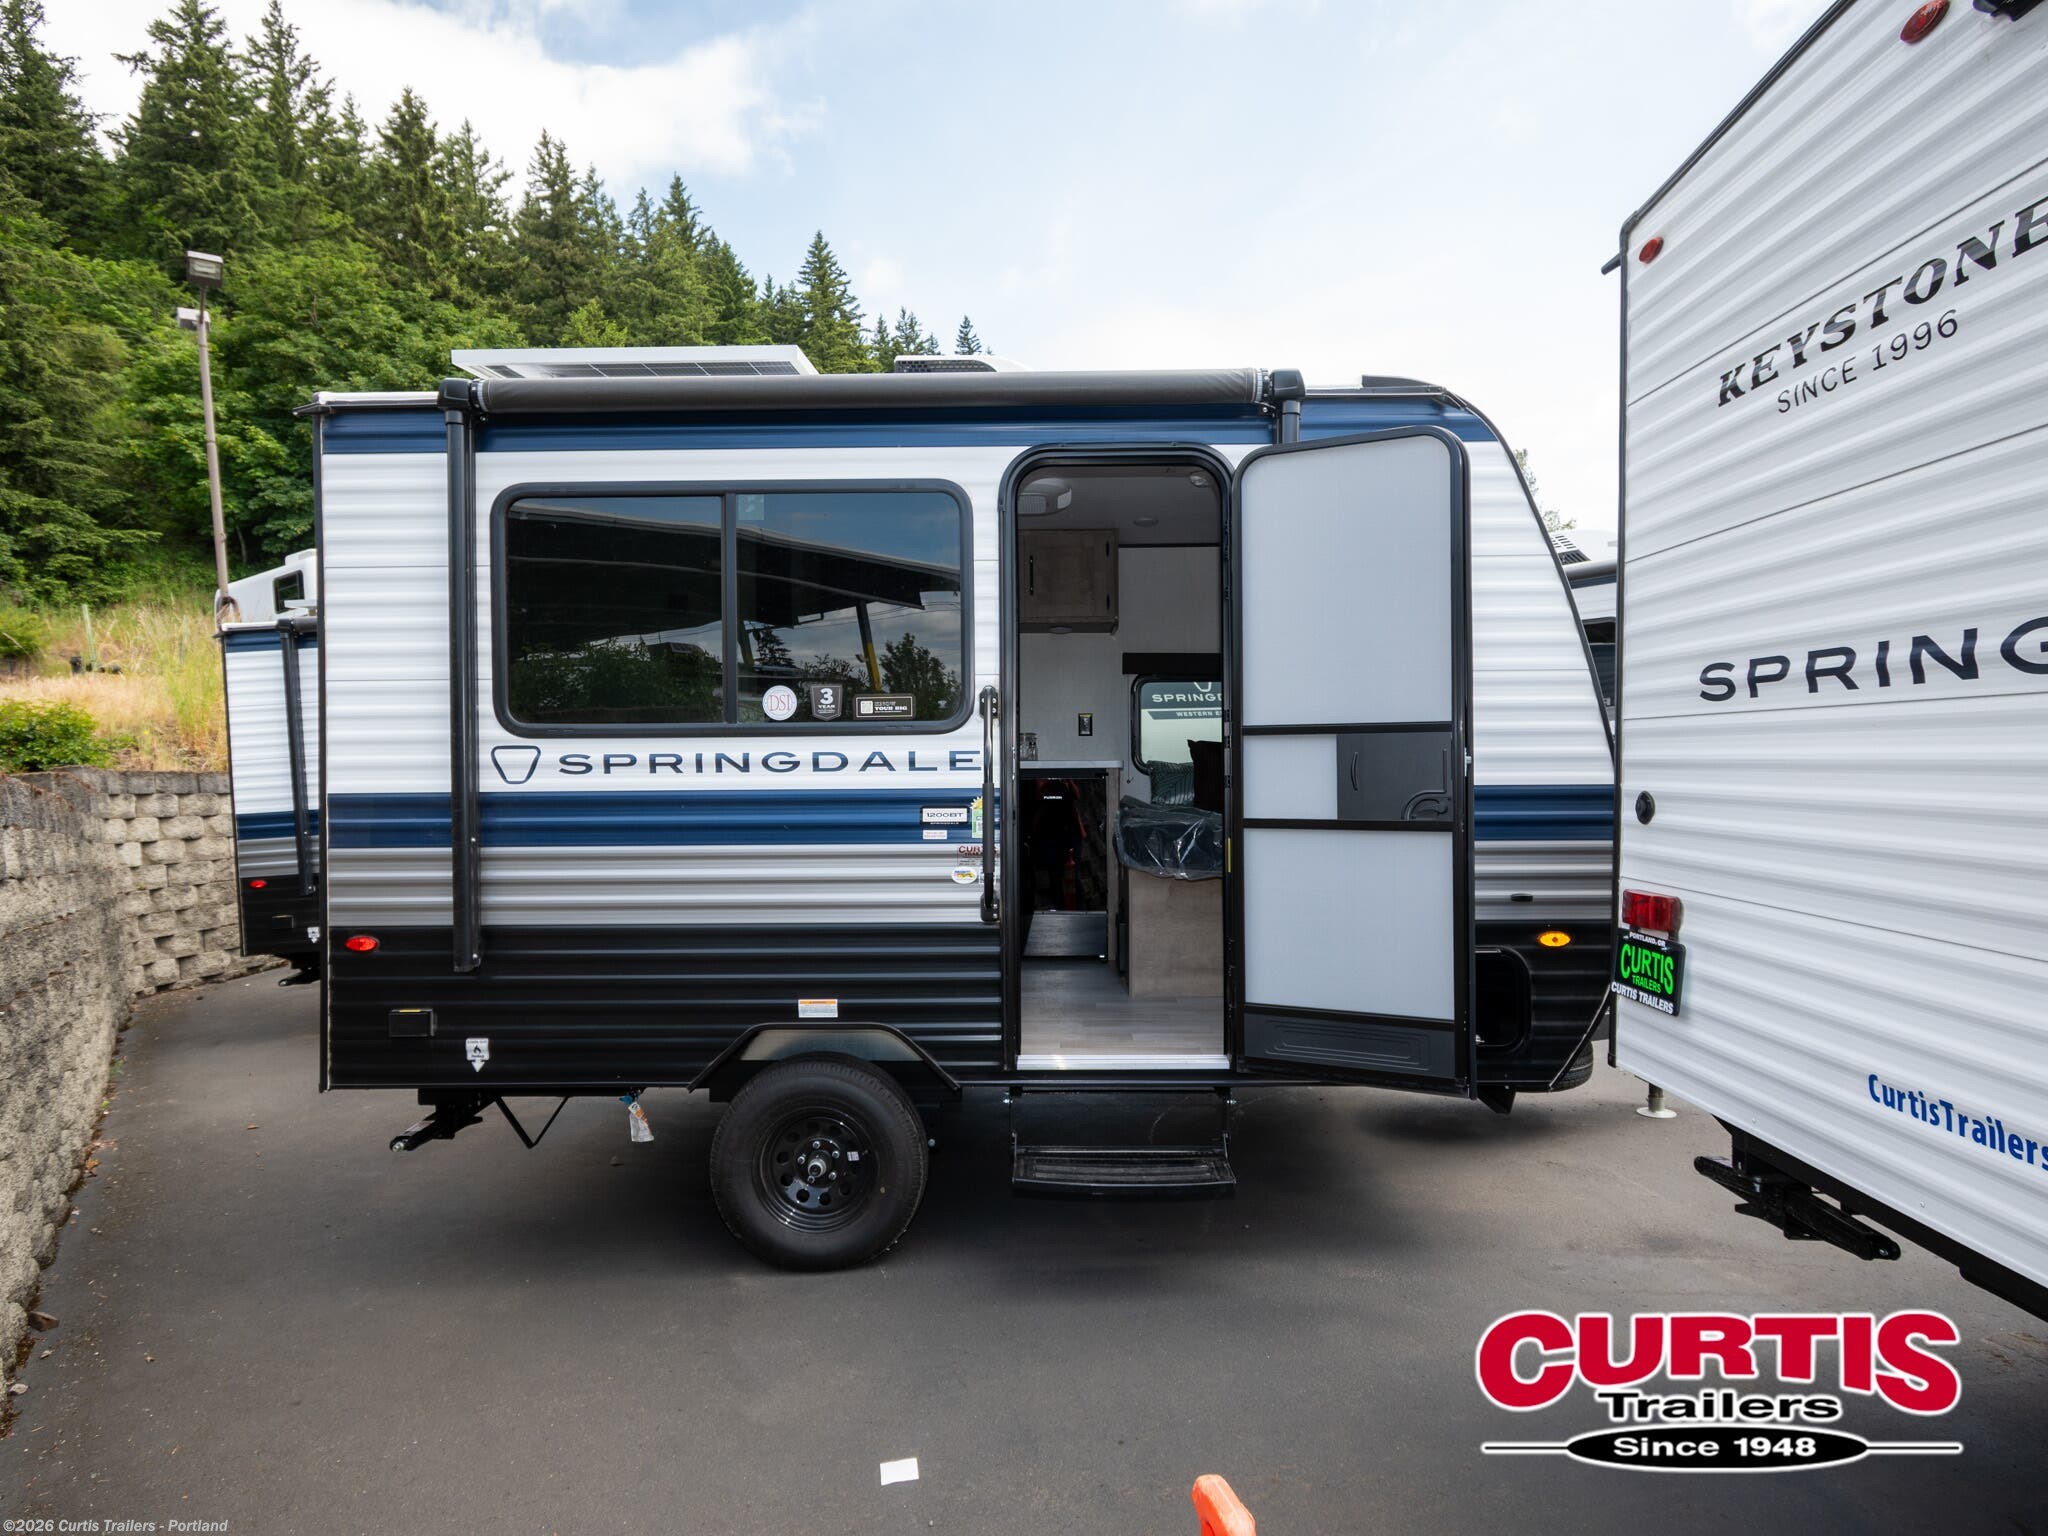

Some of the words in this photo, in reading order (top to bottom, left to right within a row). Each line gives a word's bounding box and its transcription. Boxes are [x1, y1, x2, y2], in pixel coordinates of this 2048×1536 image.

[1718, 196, 2048, 407] KEYSTONE
[1777, 356, 1857, 413] SINCE
[1873, 309, 1959, 371] 1996
[769, 694, 792, 712] DSI
[820, 688, 834, 705] 3
[559, 750, 982, 775] SPRINGDALE
[1620, 943, 1674, 995] CURTIS
[1611, 981, 1637, 1000] CURTIS
[1639, 991, 1674, 1014] TRAILERS
[1632, 974, 1662, 994] TRAILERS
